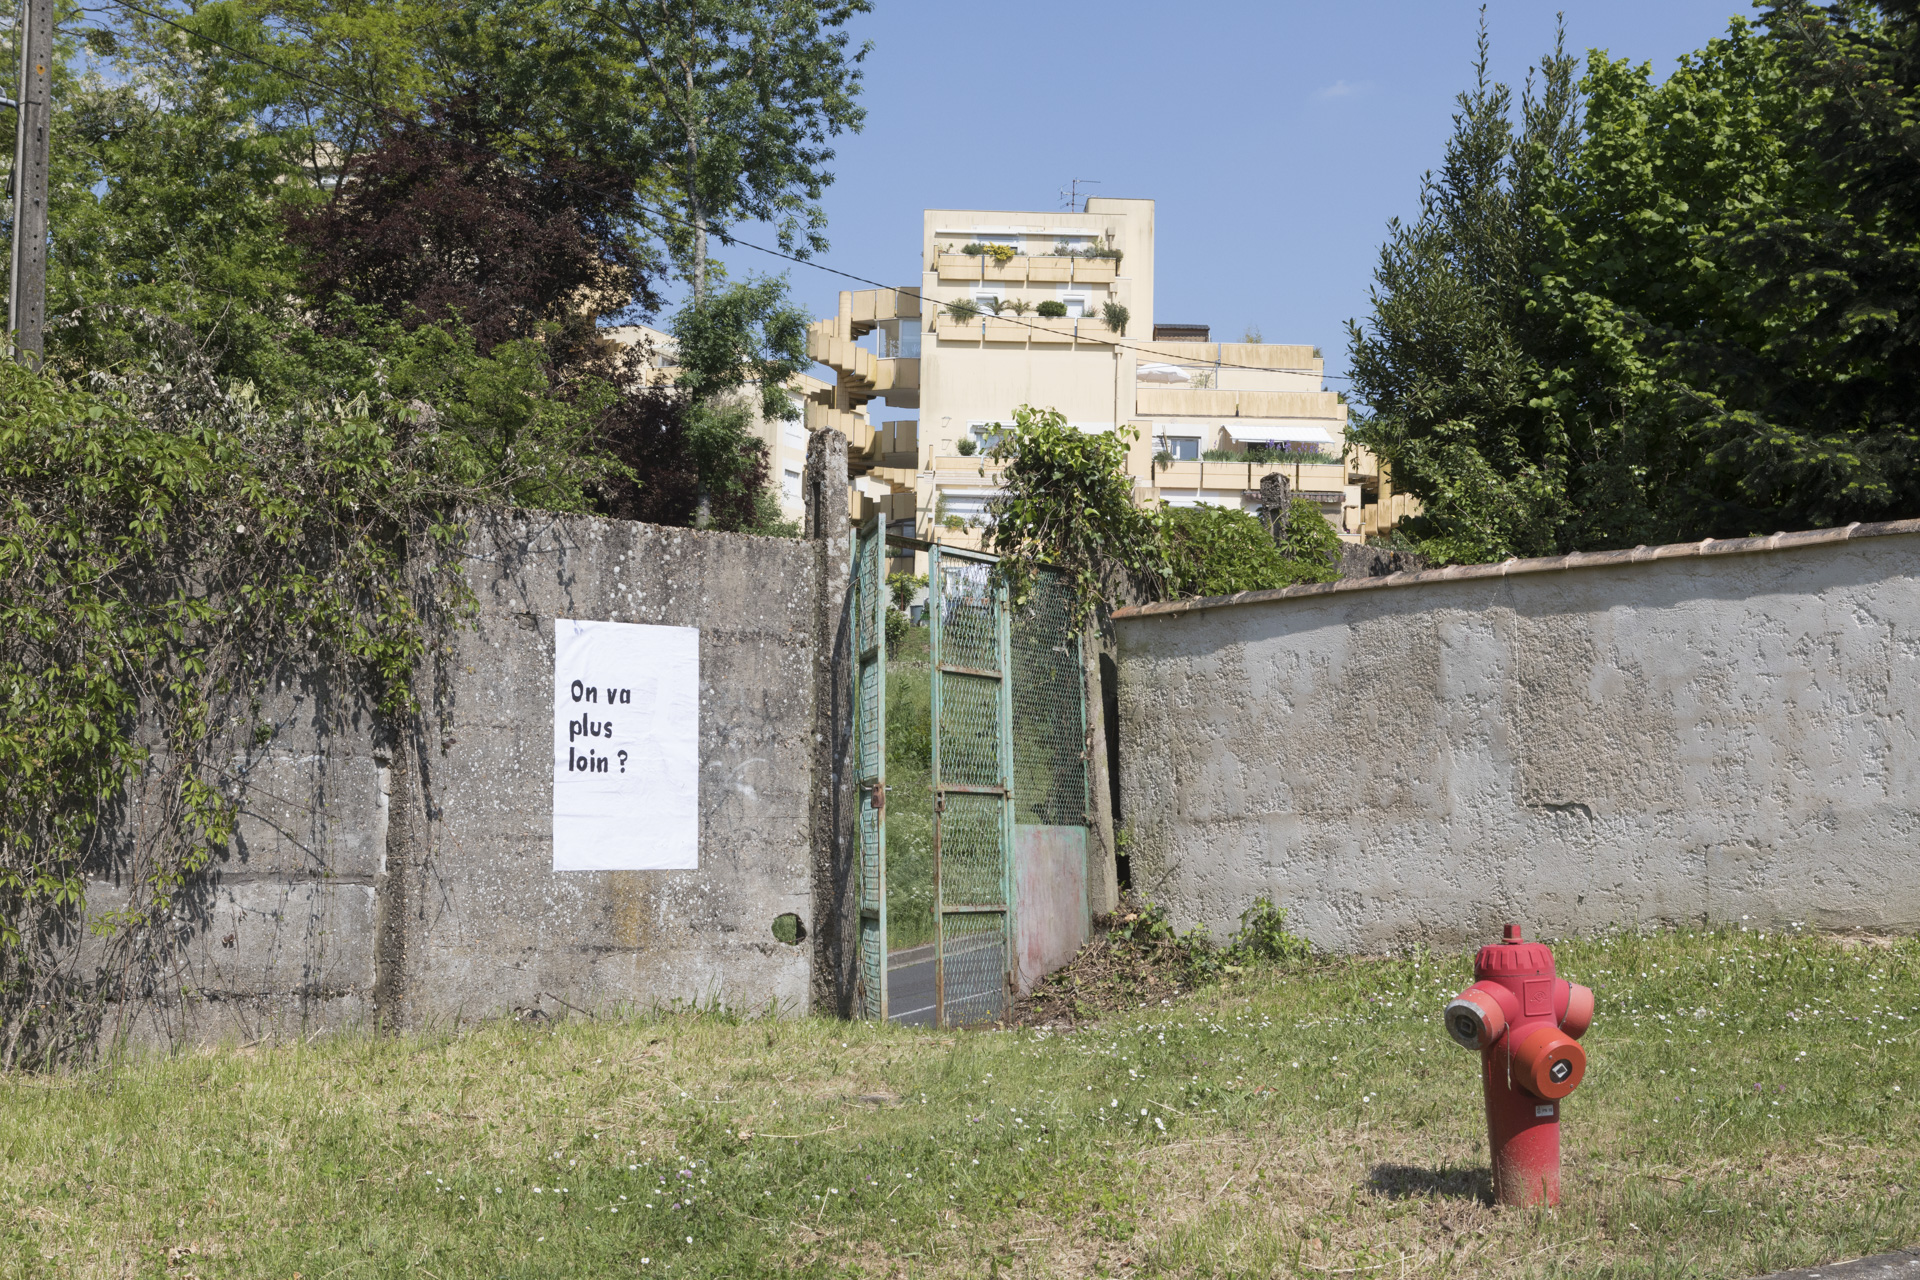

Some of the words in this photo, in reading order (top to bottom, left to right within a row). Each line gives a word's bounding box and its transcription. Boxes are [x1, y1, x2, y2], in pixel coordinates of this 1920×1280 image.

[571, 680, 597, 703] On
[607, 688, 631, 704] va
[569, 713, 613, 743] plus
[568, 747, 609, 773] loin
[617, 750, 628, 773] ?
